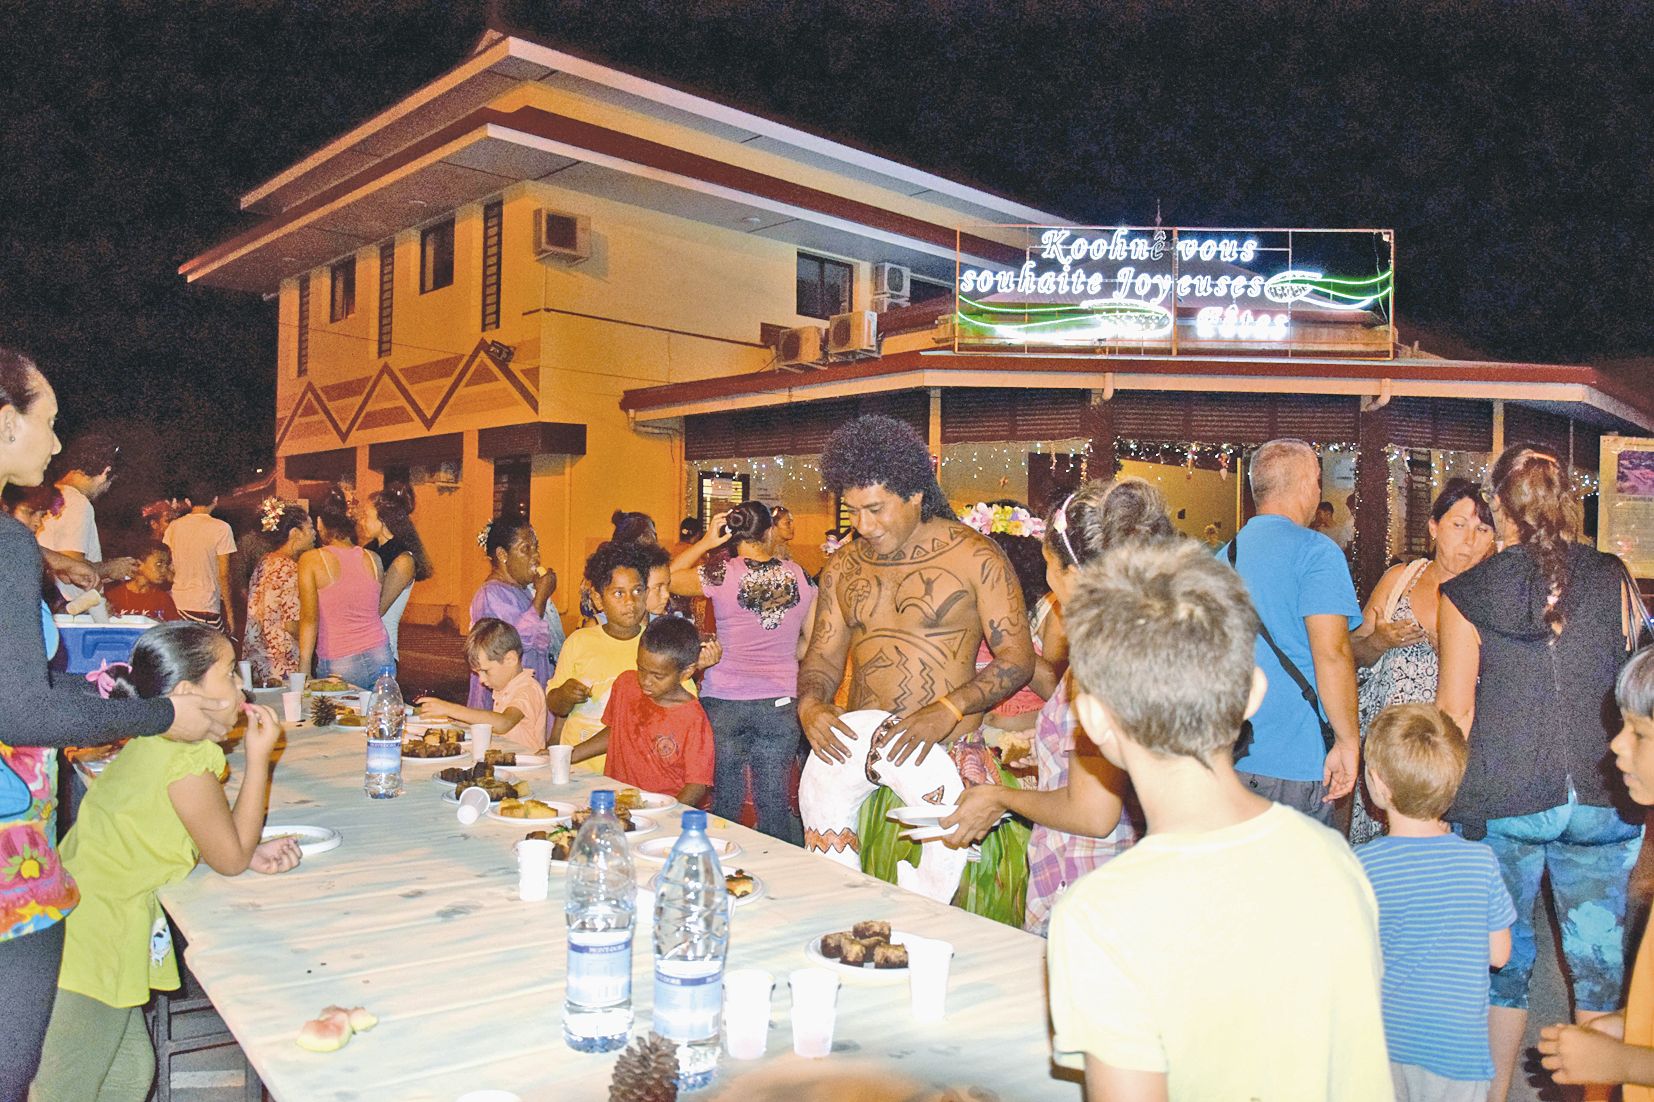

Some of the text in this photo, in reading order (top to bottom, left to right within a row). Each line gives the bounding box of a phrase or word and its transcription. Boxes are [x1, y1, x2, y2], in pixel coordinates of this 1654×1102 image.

[1041, 228, 1258, 265] Koohnê vous
[959, 261, 1266, 304] souhaite Joyeuses
